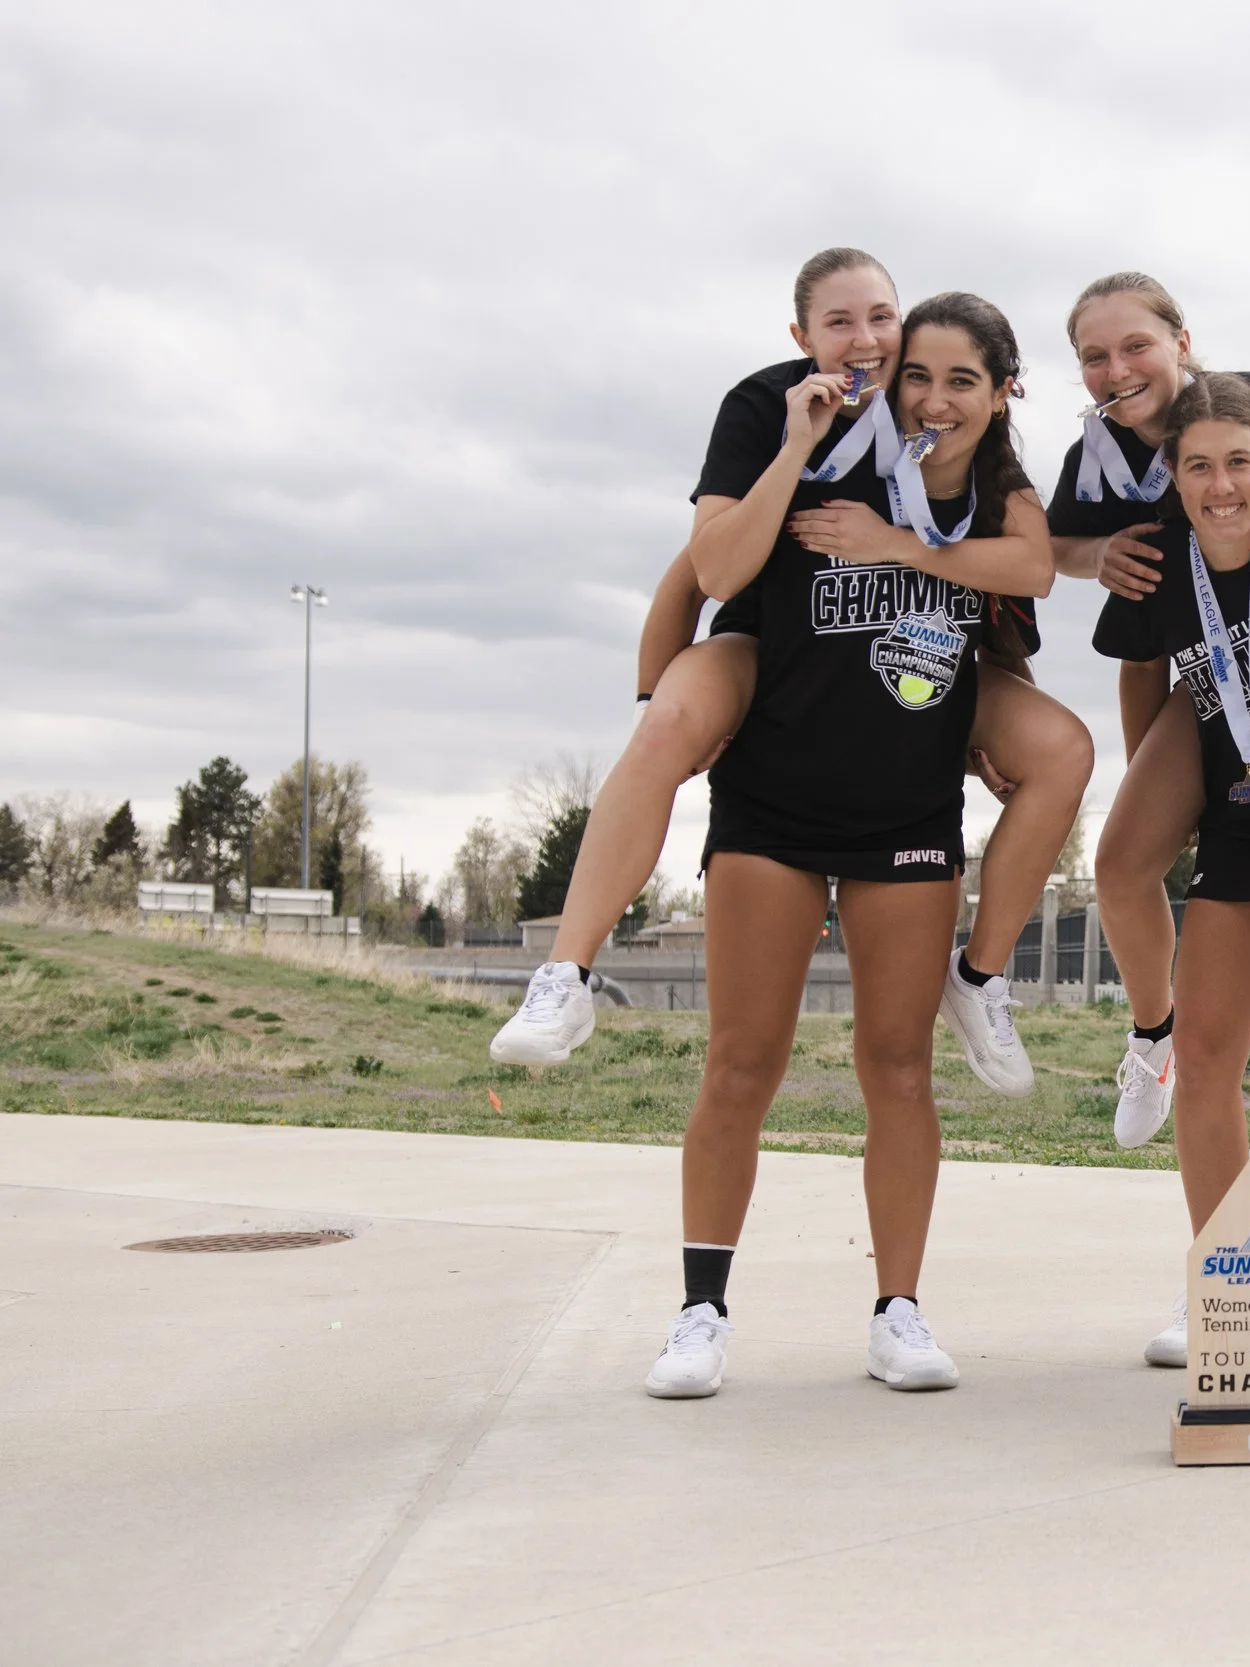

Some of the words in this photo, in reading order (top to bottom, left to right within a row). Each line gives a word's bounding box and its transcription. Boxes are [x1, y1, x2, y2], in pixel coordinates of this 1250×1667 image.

[1148, 467, 1167, 490] THE
[812, 569, 984, 630] CHAMPS
[1199, 583, 1221, 637] LEAGUE
[909, 616, 927, 625] THE
[896, 622, 962, 651] SUMMIT
[910, 640, 948, 656] LEAGUE
[913, 649, 940, 663] TENNIS
[1176, 648, 1196, 665] THE
[1212, 645, 1229, 683] SUMMIT
[894, 849, 946, 866] DENVER
